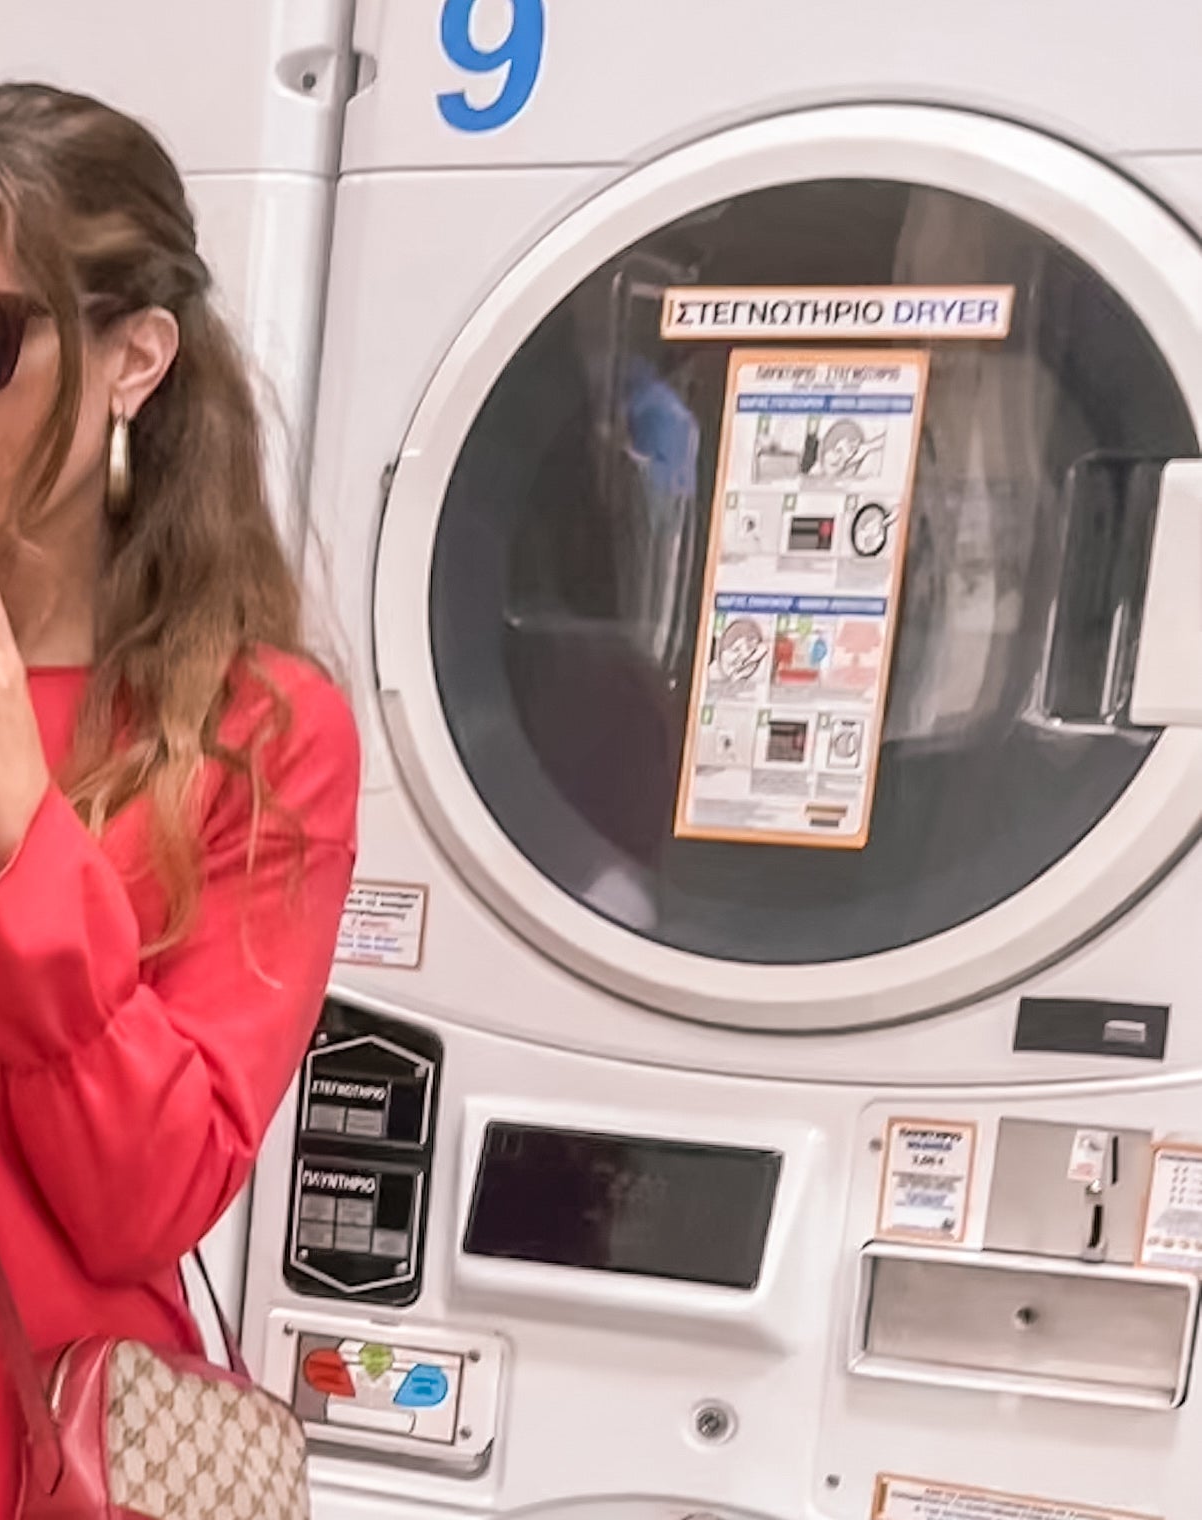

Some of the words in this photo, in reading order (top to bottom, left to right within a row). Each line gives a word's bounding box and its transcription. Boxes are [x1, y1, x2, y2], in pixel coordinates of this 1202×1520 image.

[436, 0, 544, 132] 9
[675, 299, 885, 326] ΣΤΕΓΝΩΤΗΡΙΟ
[892, 299, 999, 326] DRYER
